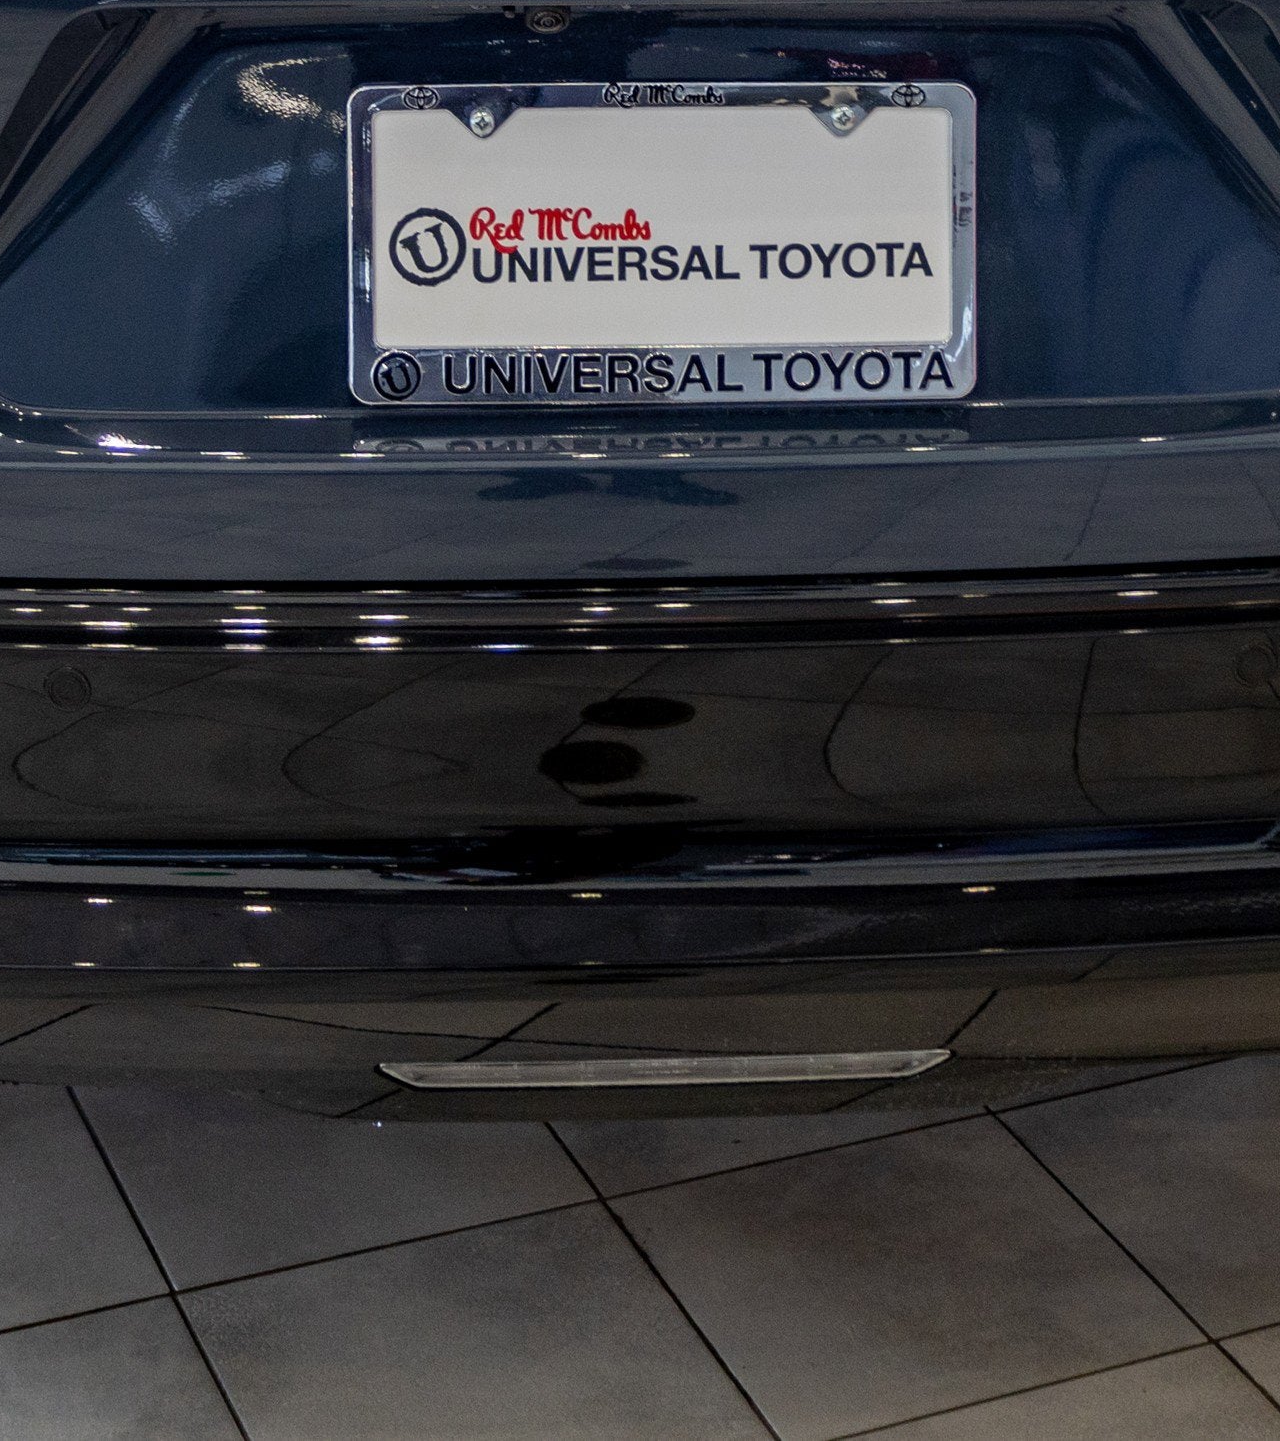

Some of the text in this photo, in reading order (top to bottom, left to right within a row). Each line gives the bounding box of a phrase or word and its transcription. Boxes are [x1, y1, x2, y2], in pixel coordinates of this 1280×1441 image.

[602, 82, 725, 109] Red McCombs
[470, 206, 652, 254] Red McCombs
[472, 242, 933, 283] UNIVERSAL TOYOTA
[444, 350, 955, 395] UNIVERSAL TOYOTA
